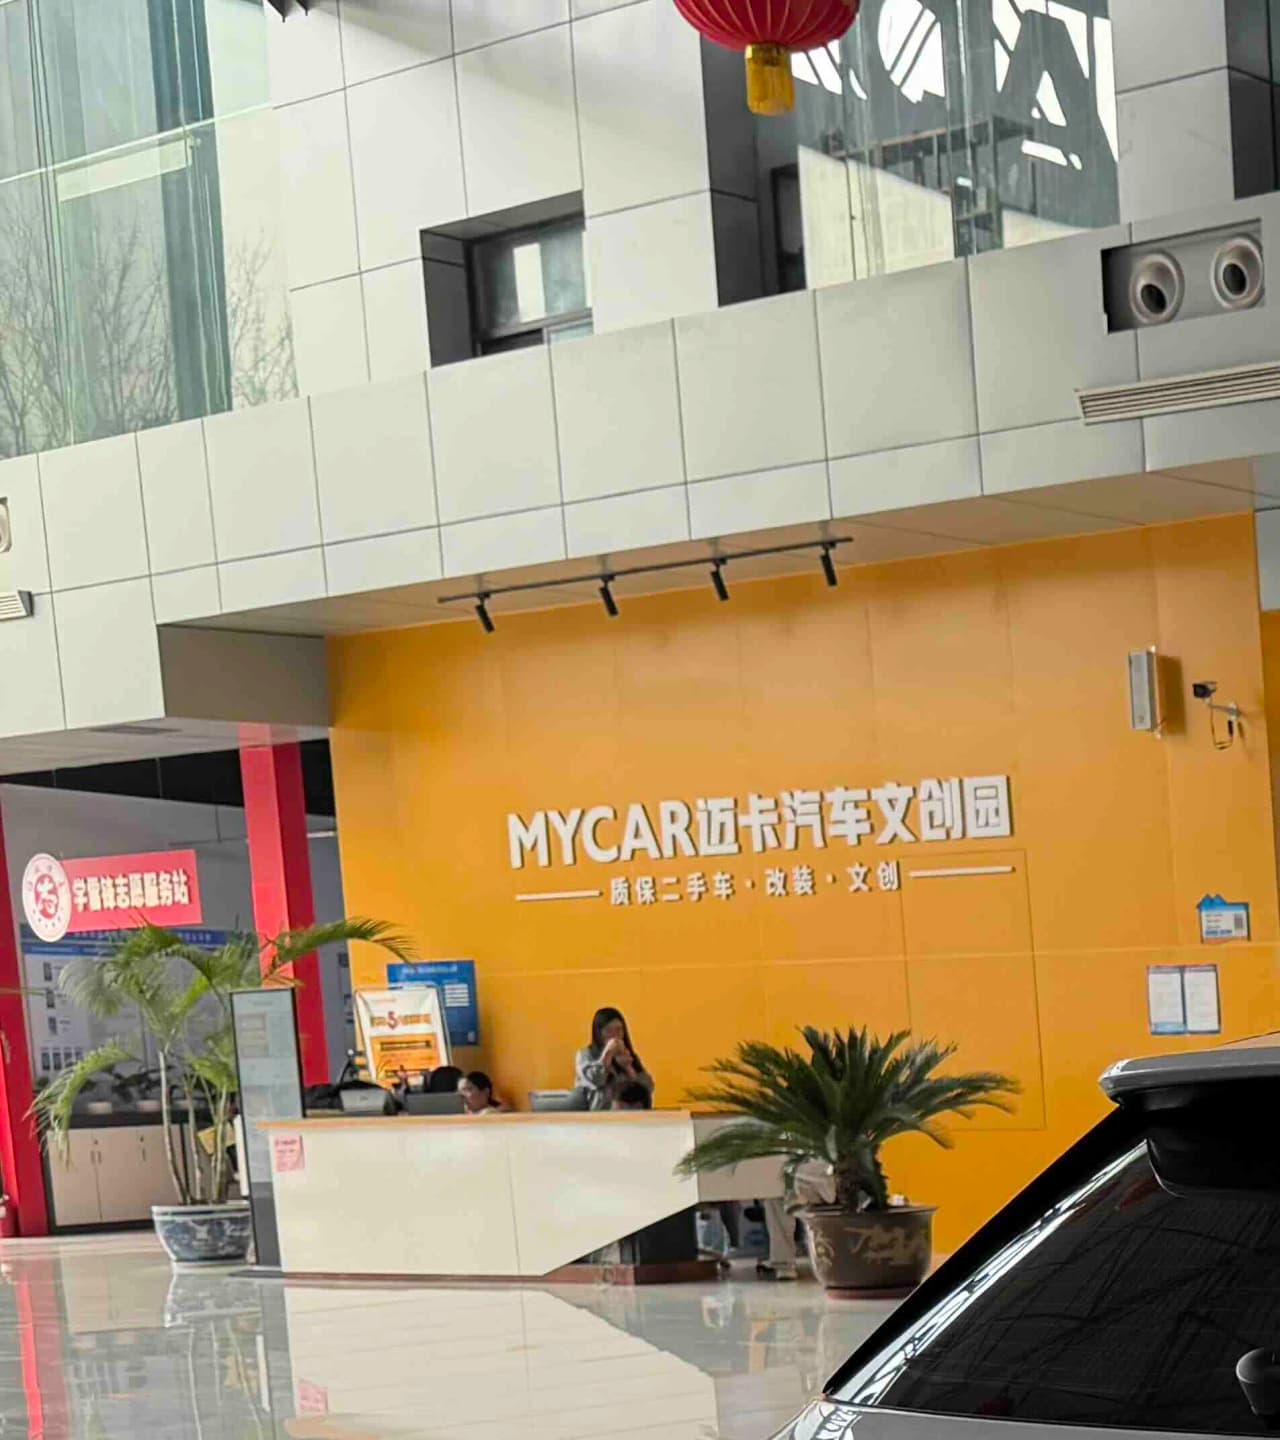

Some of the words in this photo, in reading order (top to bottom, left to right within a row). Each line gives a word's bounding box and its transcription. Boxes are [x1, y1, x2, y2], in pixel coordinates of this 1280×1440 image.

[507, 775, 1012, 868] MYCAR迈卡汽车文创园
